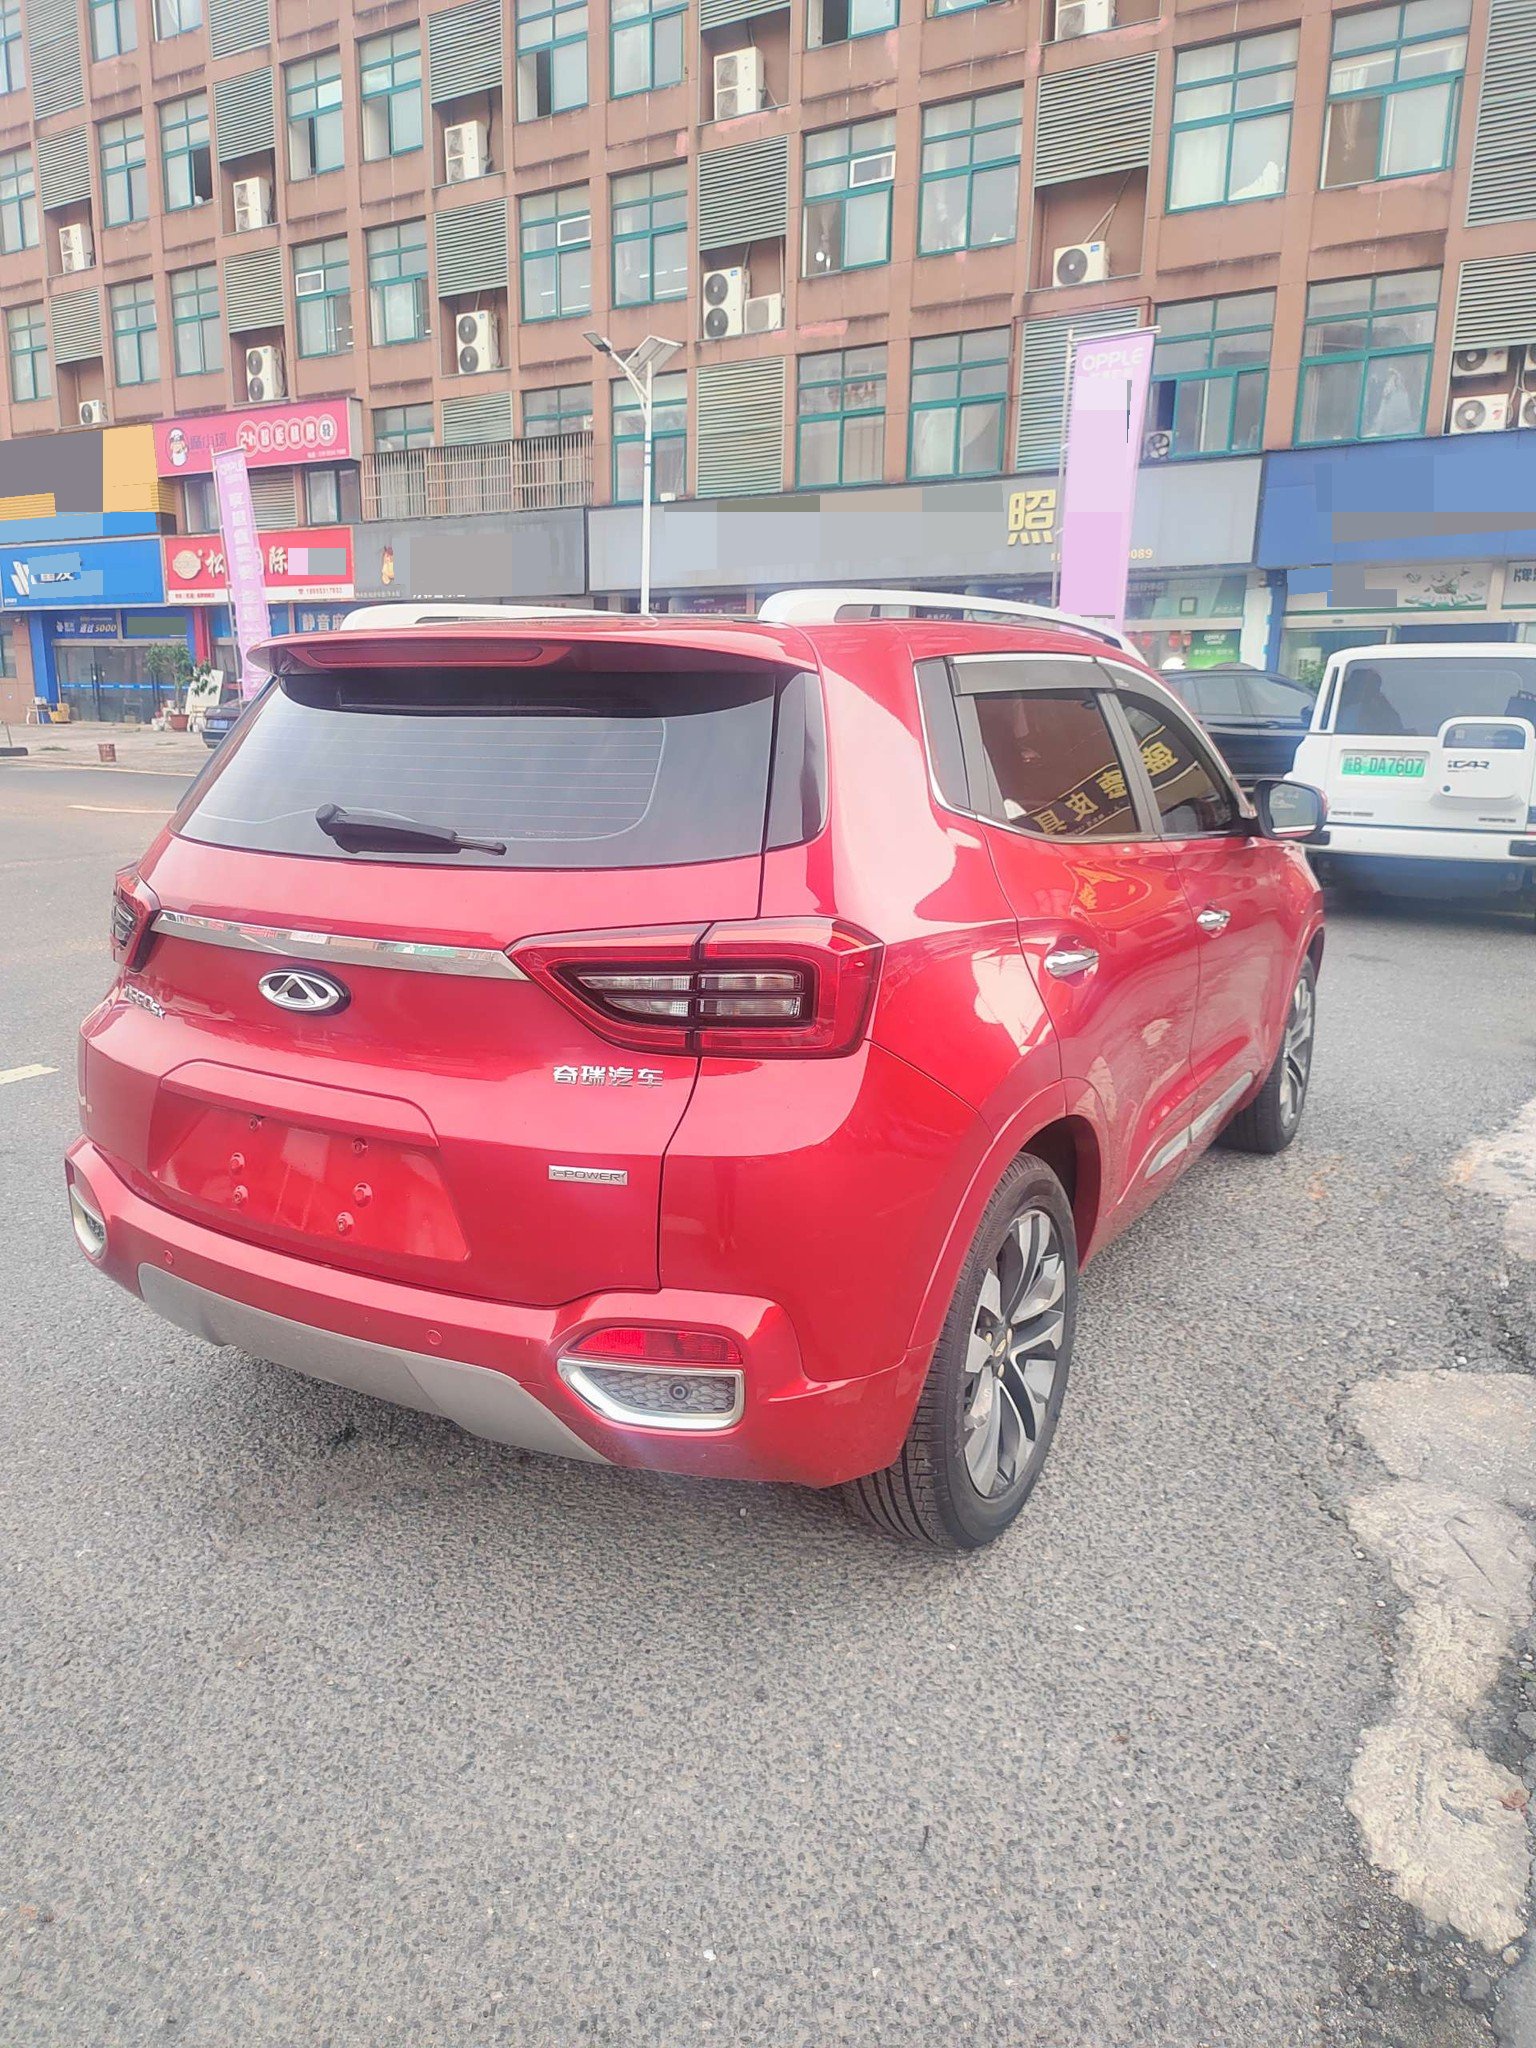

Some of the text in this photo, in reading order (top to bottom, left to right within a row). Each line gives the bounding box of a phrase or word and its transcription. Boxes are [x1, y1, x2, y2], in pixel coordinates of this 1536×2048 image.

[1083, 347, 1144, 371] OPPLE
[1008, 489, 1056, 545] 照
[552, 1065, 664, 1088] 奇瑞汽车
